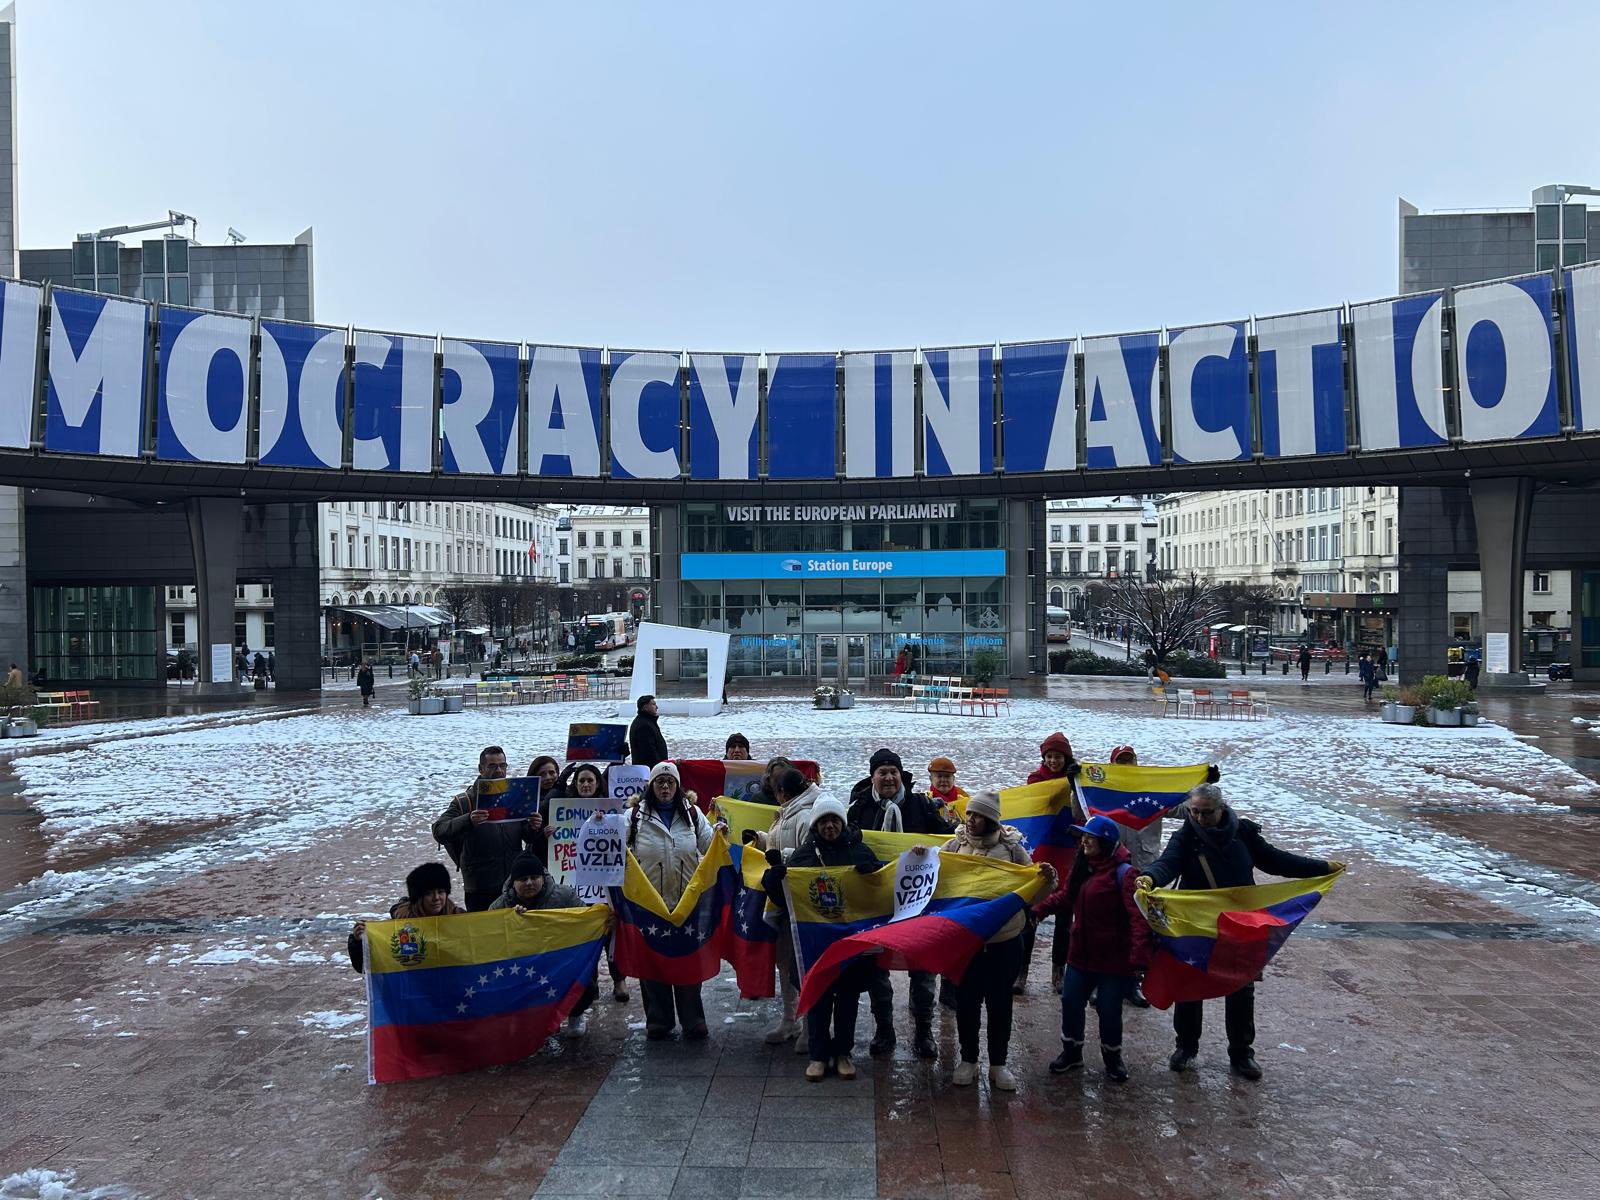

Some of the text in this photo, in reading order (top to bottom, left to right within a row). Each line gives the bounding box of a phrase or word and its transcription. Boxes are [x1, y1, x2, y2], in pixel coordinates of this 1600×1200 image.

[845, 350, 980, 478] IN
[727, 503, 957, 521] VISIT THE EUROPEAN PARLIAMENT
[807, 559, 893, 574] Station Europe
[966, 636, 1003, 646] Welkom
[588, 828, 619, 836] EUROPA
[583, 838, 622, 853] CON
[579, 853, 624, 867] VZLA
[904, 863, 933, 872] EUROPA
[900, 872, 935, 891] CON
[895, 886, 933, 906] VZLA
